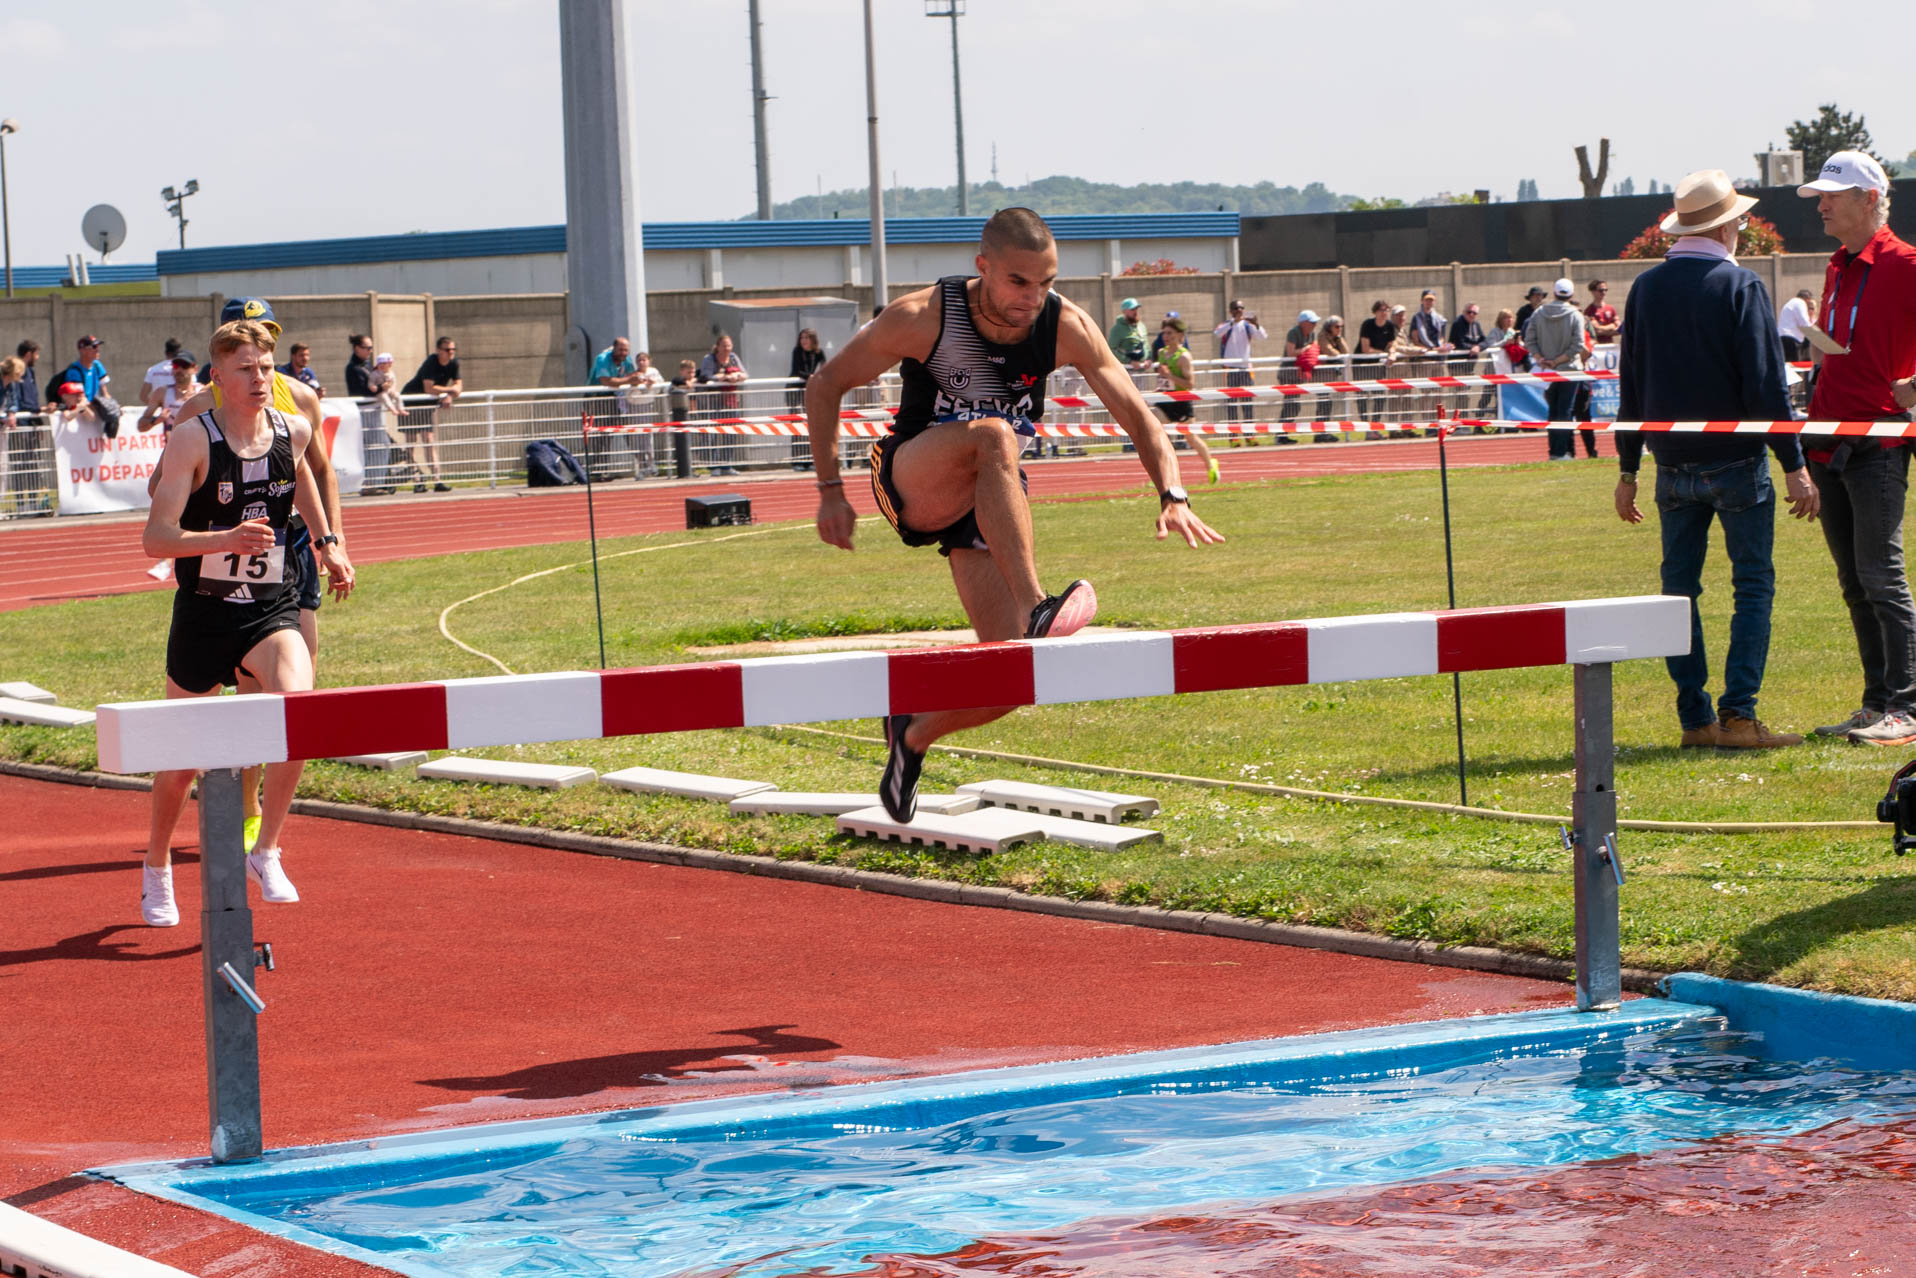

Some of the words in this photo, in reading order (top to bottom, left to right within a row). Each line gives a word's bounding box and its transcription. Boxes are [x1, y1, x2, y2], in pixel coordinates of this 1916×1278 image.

[88, 438, 112, 453] UN
[71, 467, 94, 483] DU
[241, 507, 267, 520] HBA
[224, 552, 268, 579] 15
